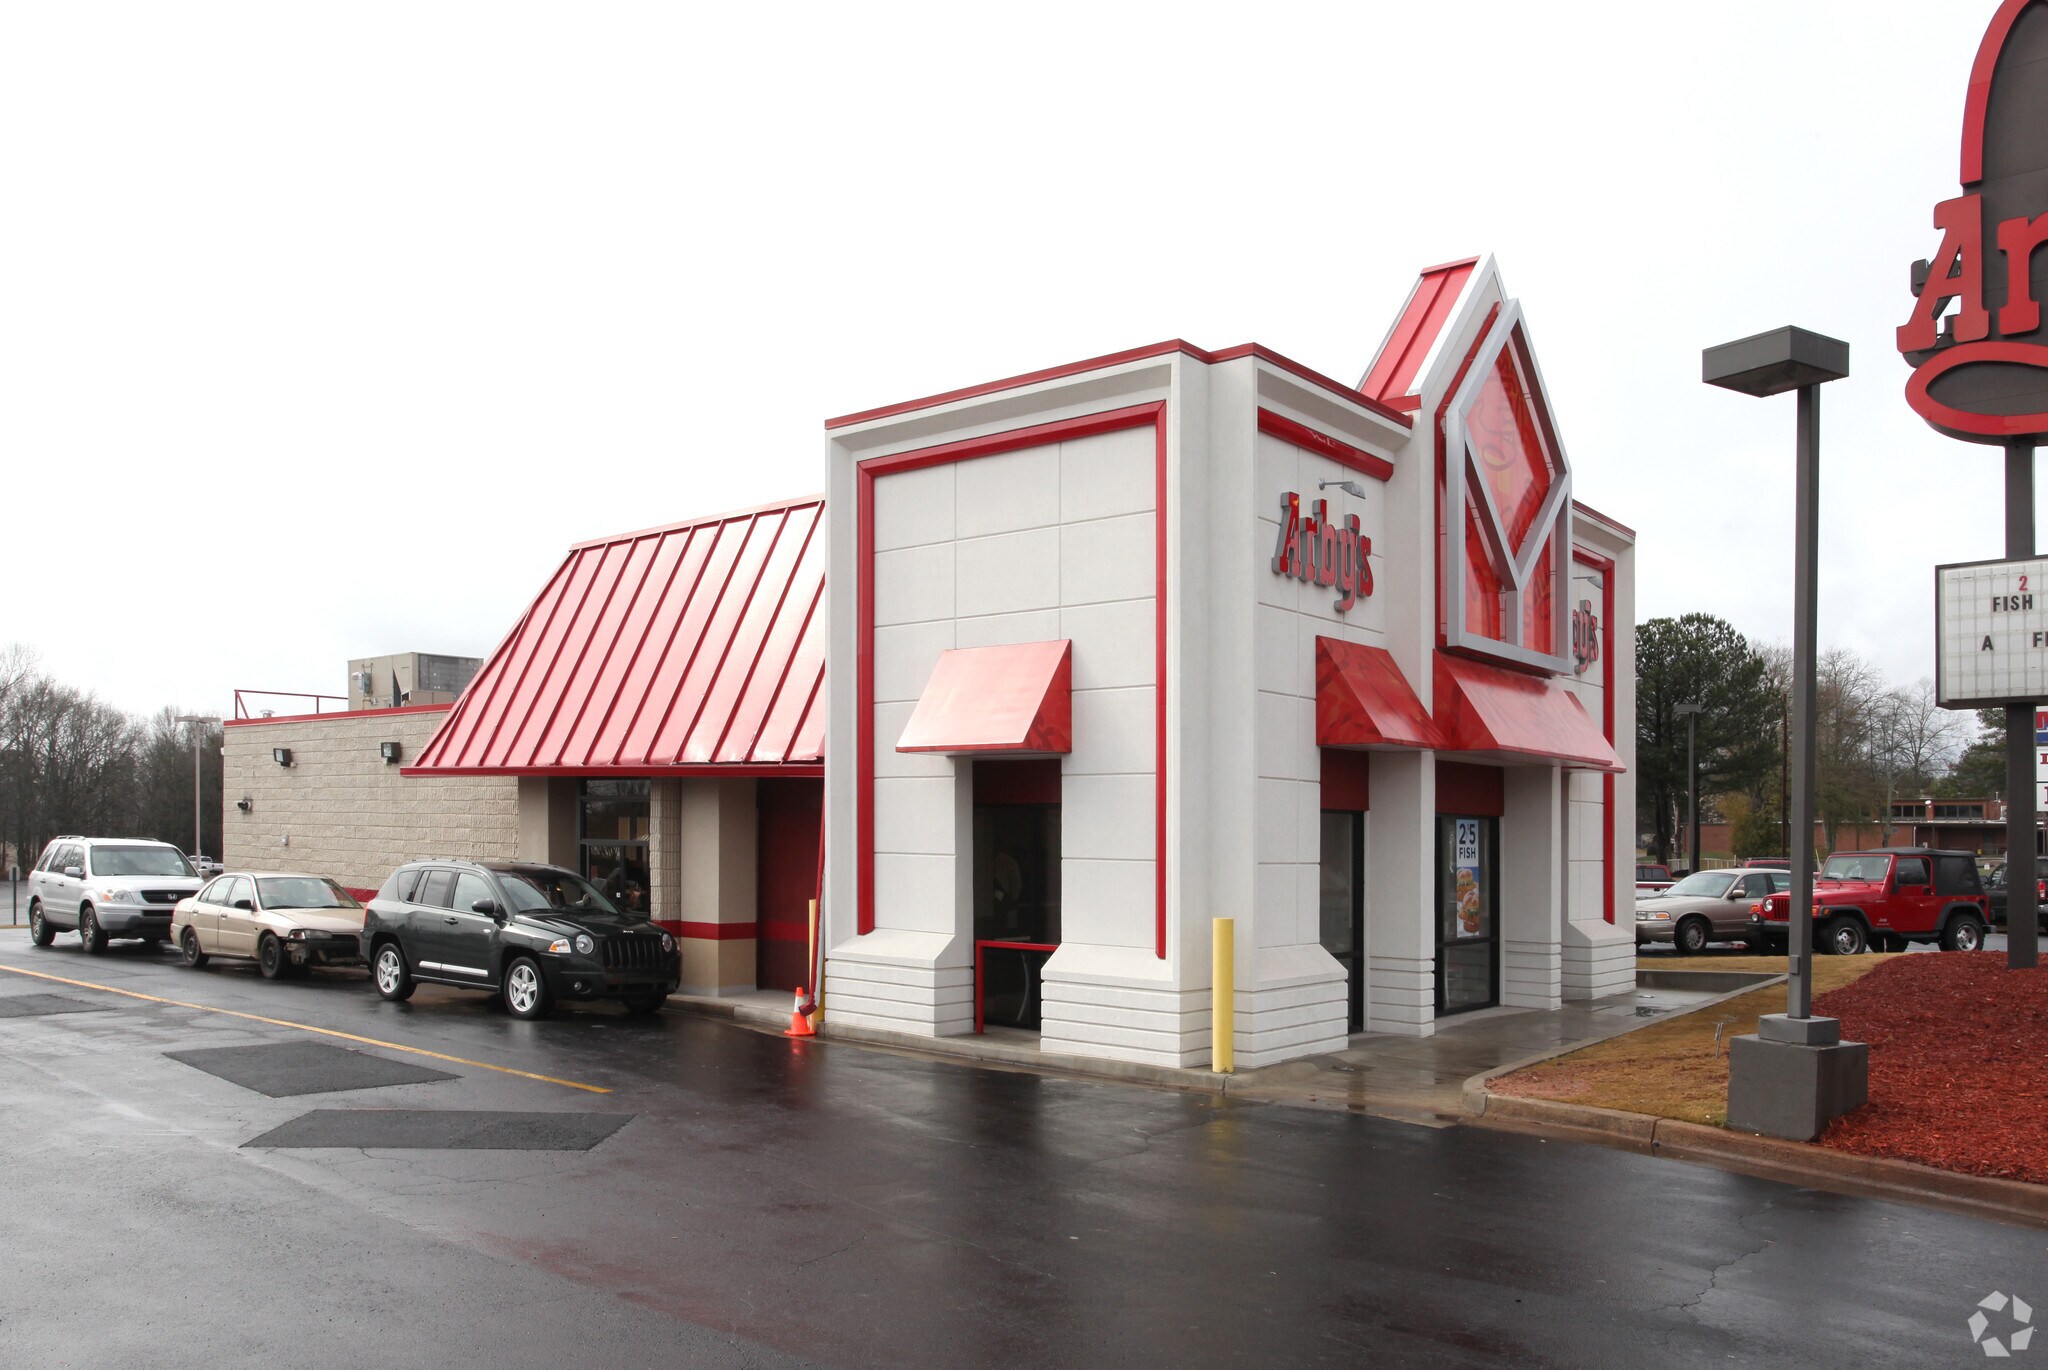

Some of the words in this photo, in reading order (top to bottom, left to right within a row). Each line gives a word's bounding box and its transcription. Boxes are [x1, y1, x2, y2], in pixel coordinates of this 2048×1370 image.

[1272, 491, 1374, 611] Arby's
[2018, 575, 2028, 591] 2
[1992, 594, 2033, 612] FISH
[1981, 635, 1994, 651] A
[1459, 846, 1476, 859] FISH
